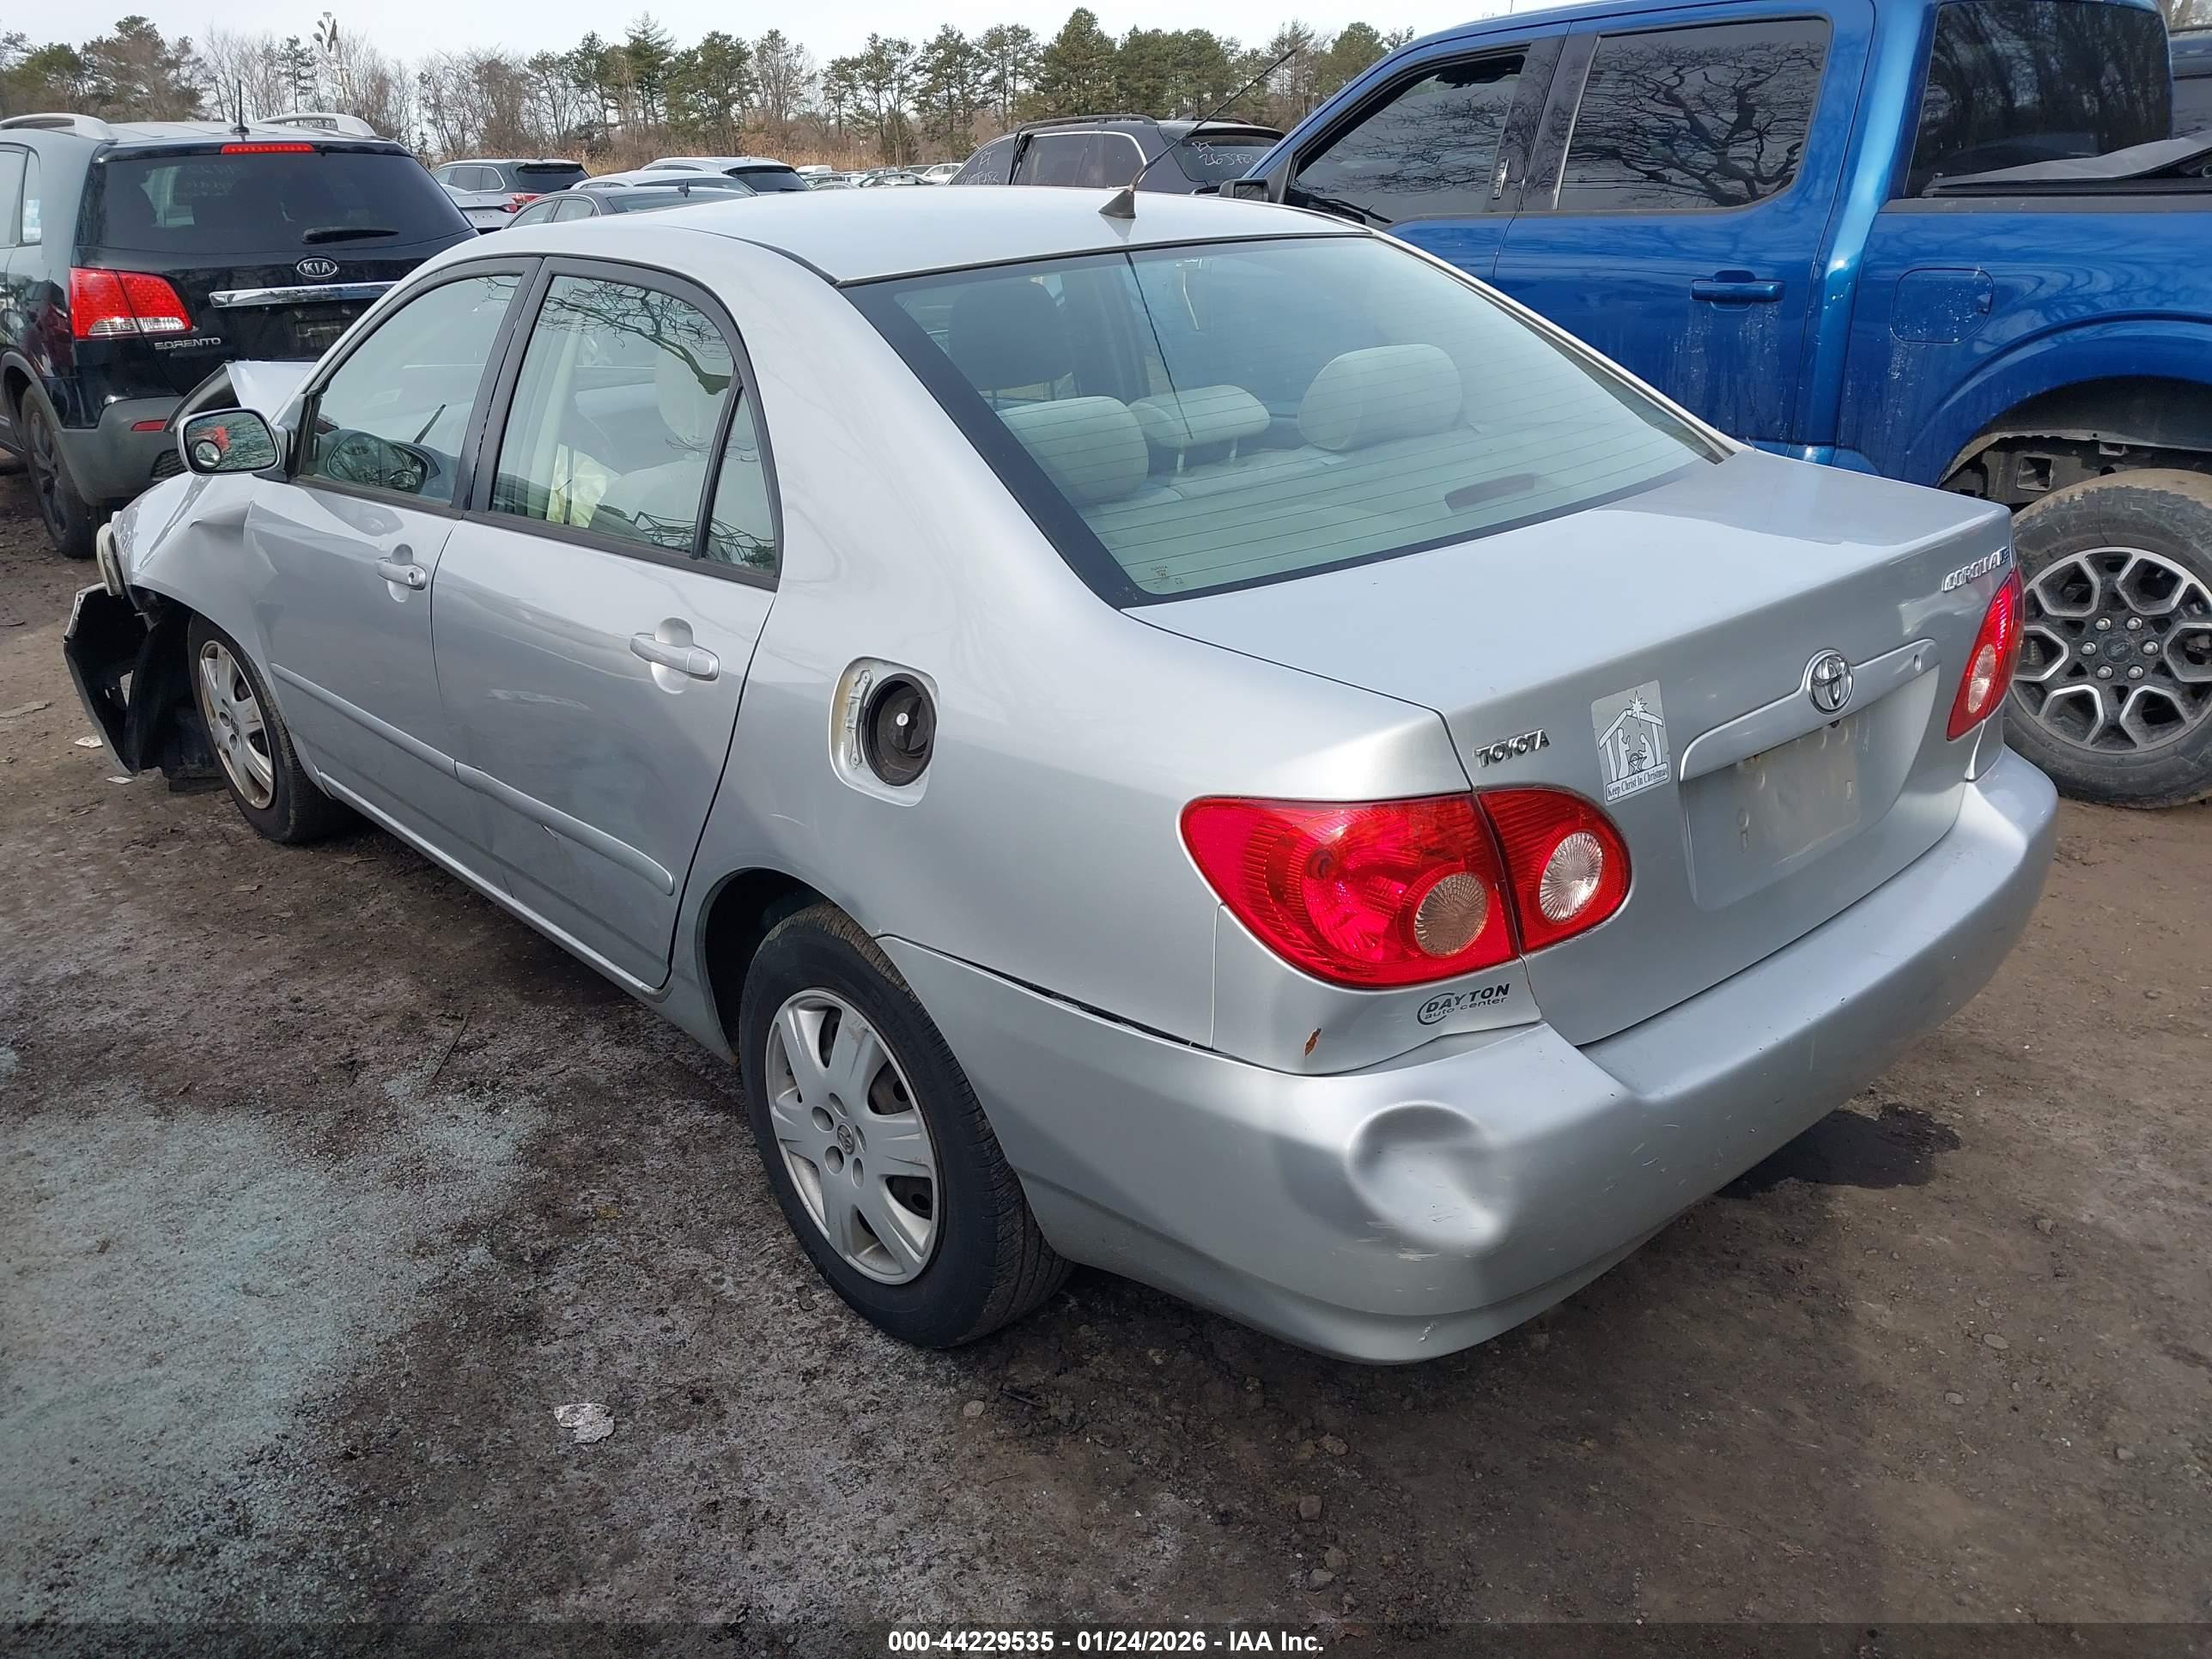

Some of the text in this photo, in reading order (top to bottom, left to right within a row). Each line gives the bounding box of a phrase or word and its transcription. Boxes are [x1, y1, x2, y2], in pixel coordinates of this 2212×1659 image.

[303, 262, 331, 274] KIA
[154, 337, 222, 350] SORENTO
[1474, 728, 1550, 768] TOYOTA
[1607, 785, 1621, 798] Keep
[1621, 777, 1637, 792] Christ
[1644, 768, 1668, 783] Christmas
[1425, 983, 1510, 1013] DAYTON
[1425, 997, 1507, 1019] auto center
